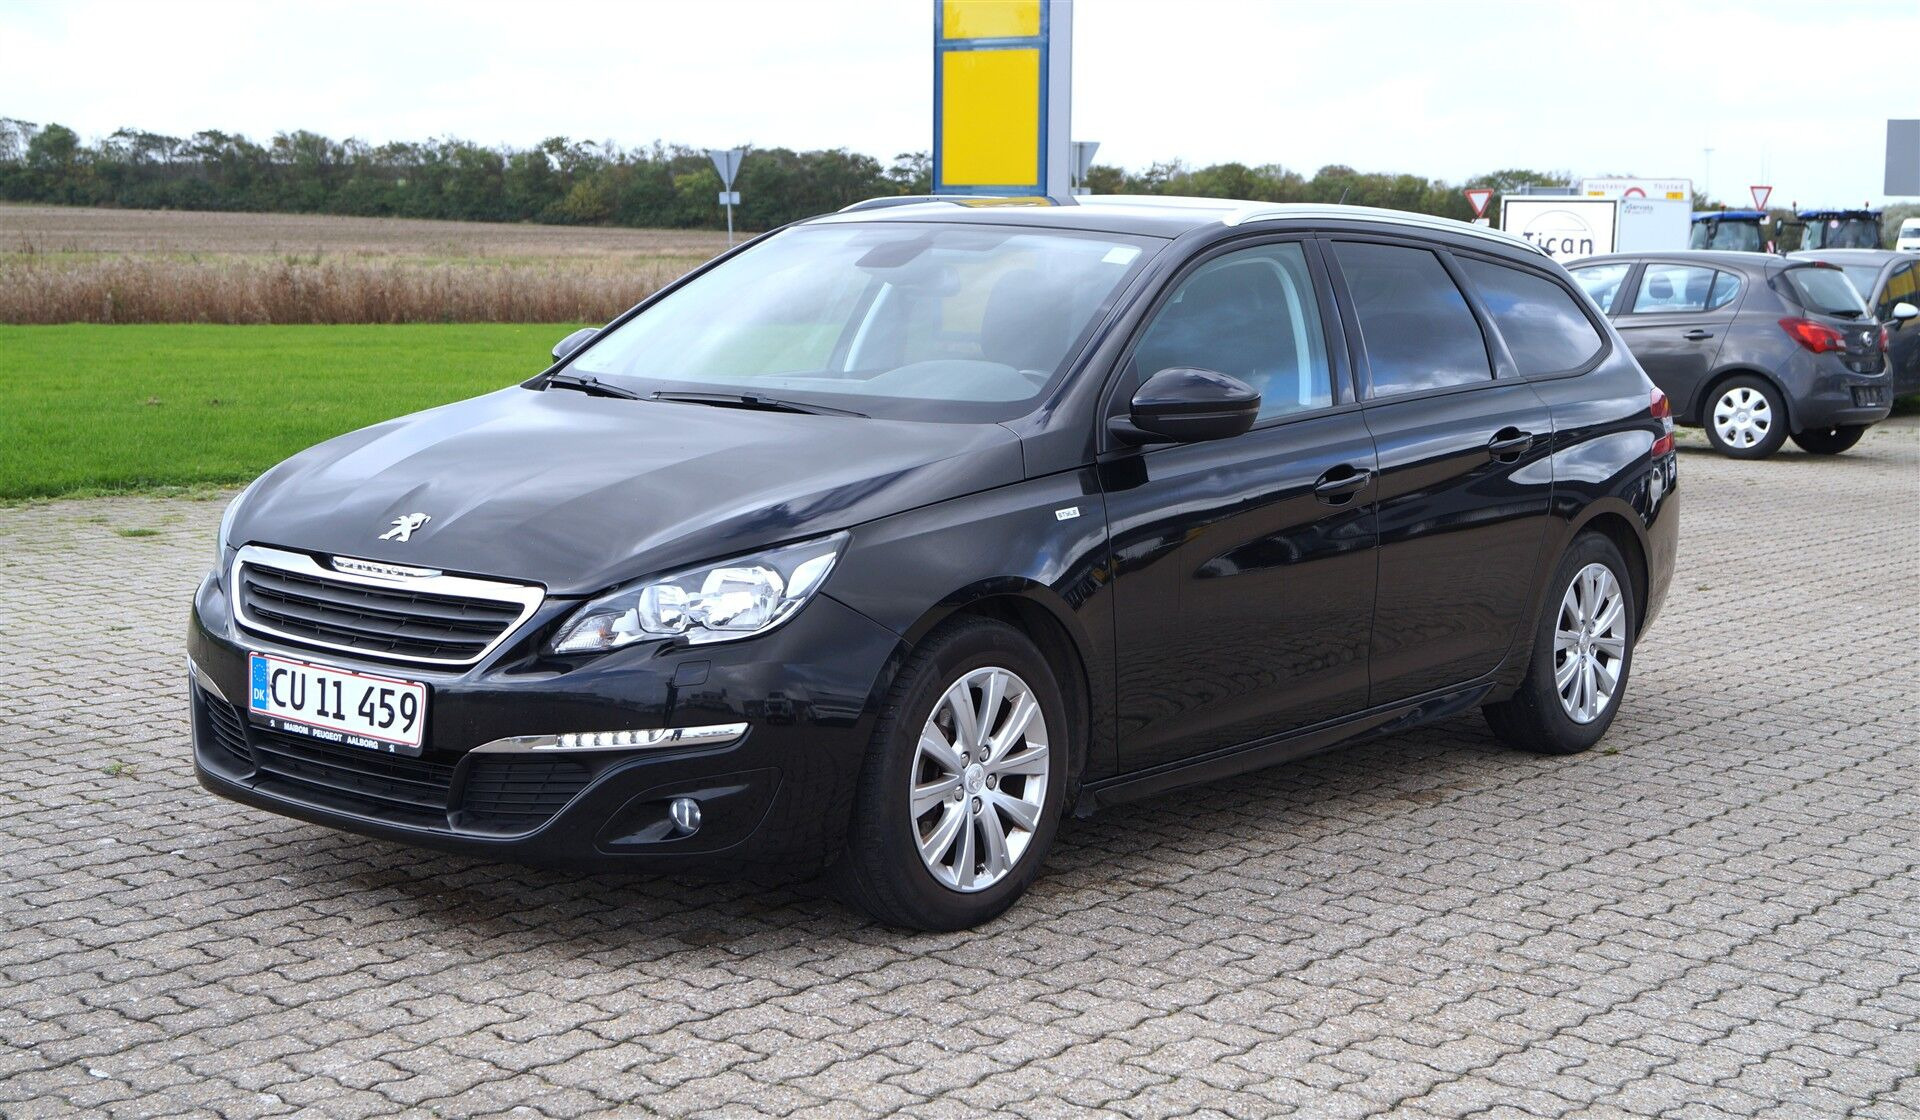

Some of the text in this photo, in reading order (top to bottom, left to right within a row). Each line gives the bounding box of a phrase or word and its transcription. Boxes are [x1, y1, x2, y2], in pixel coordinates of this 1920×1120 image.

[1523, 231, 1593, 255] Tican
[1057, 509, 1078, 519] STYLE
[253, 687, 265, 702] DK
[270, 667, 418, 734] CU 11 459
[312, 728, 342, 742] PEUGEOT
[346, 735, 379, 750] AALBORG
